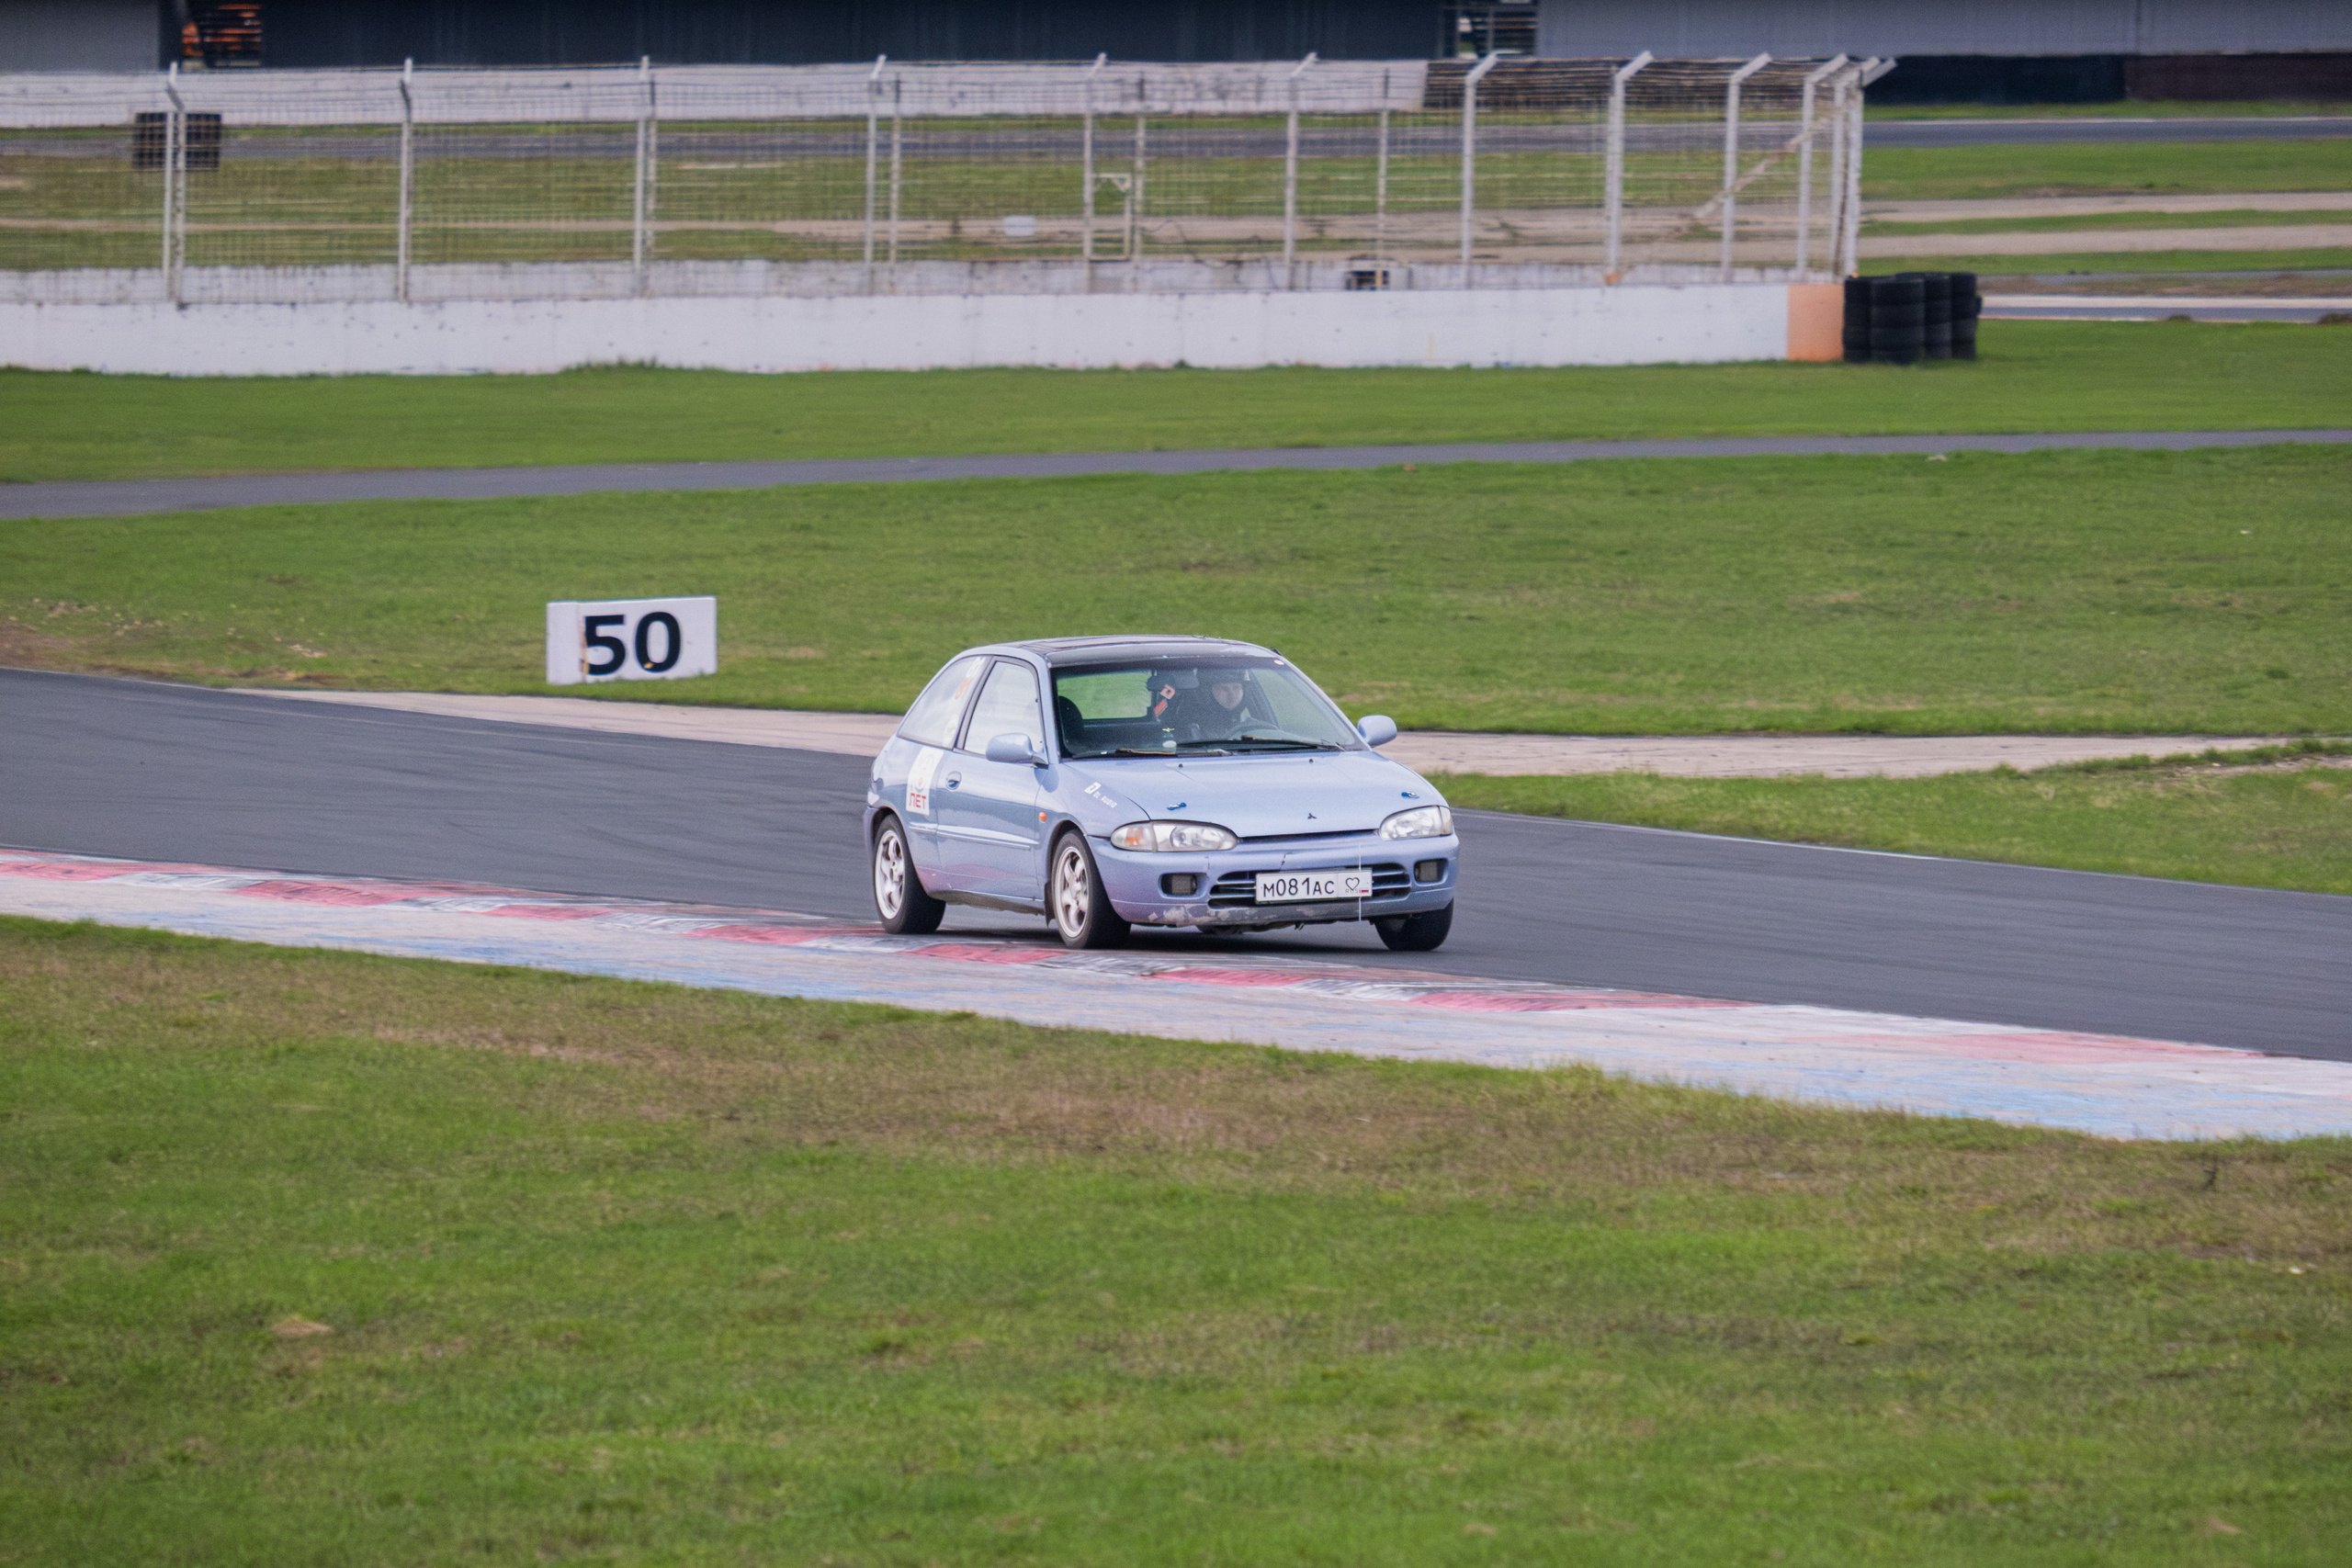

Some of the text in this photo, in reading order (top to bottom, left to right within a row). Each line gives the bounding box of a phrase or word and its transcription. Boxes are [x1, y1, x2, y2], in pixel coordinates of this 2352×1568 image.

[581, 612, 682, 675] 50
[909, 793, 927, 809] ЛЕТ
[1262, 877, 1335, 897] М081АС
